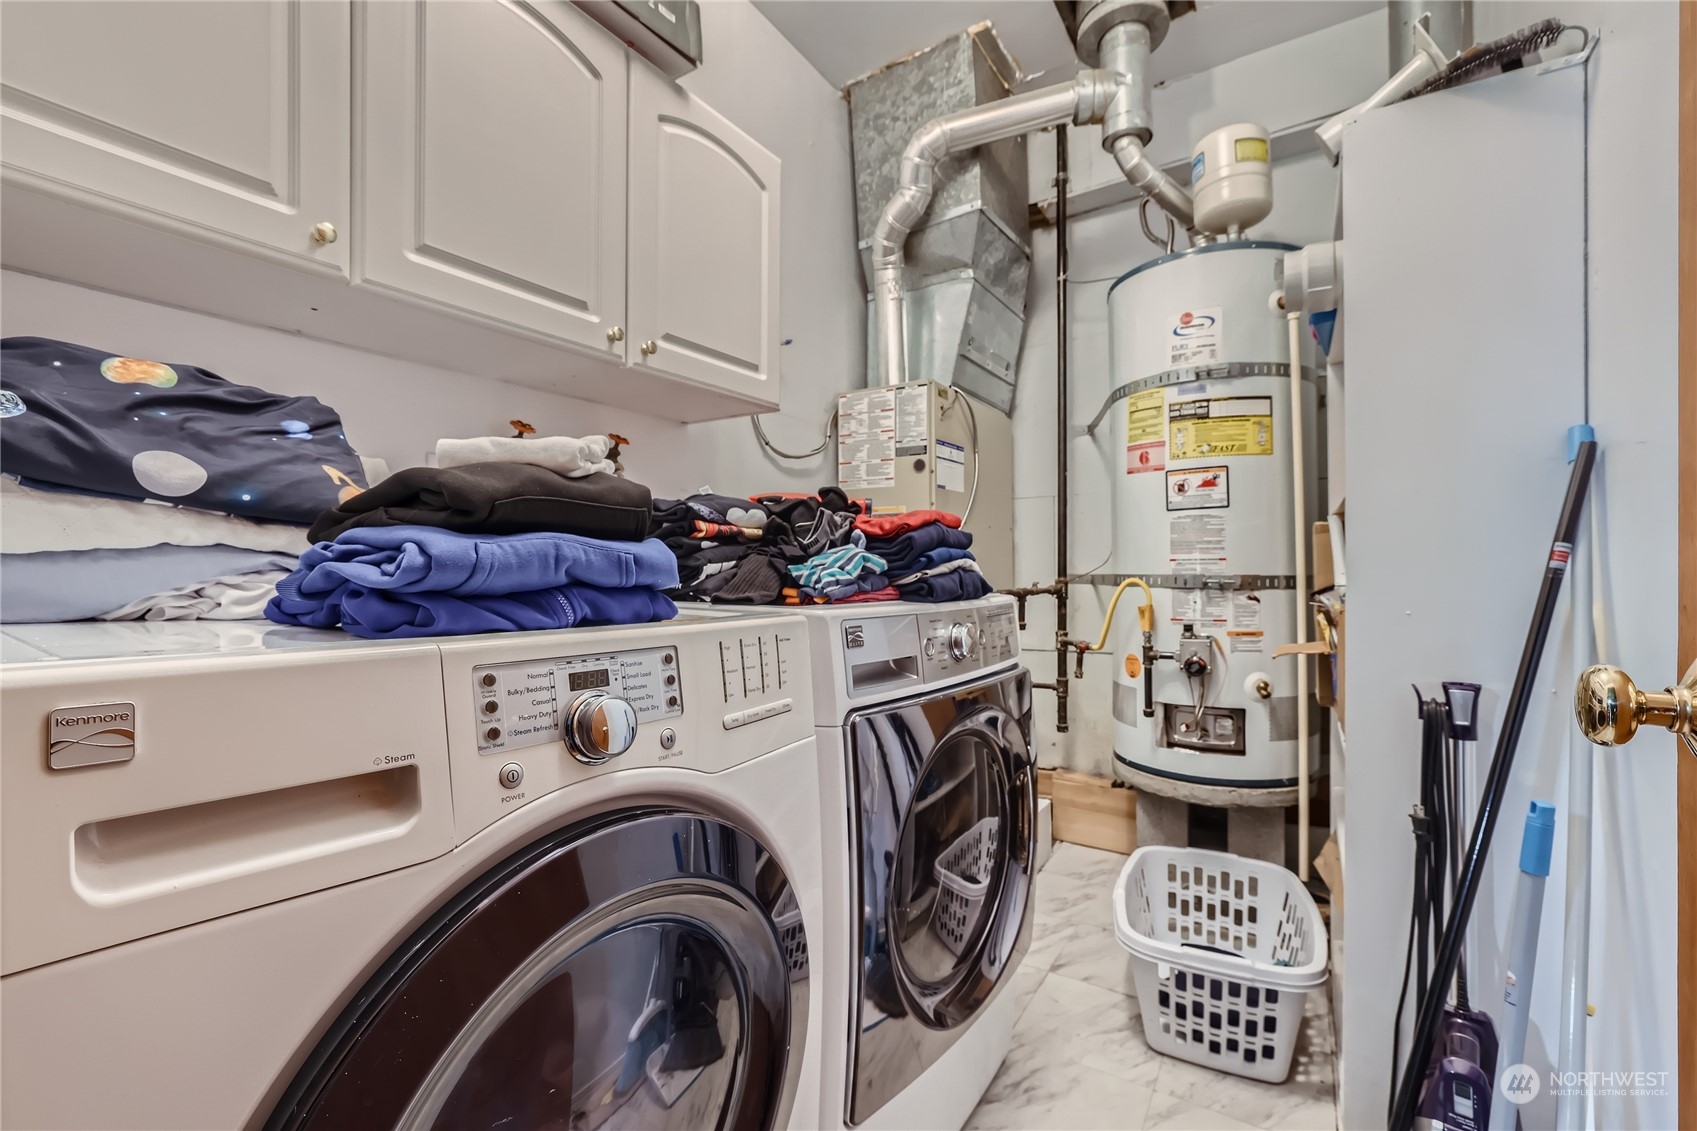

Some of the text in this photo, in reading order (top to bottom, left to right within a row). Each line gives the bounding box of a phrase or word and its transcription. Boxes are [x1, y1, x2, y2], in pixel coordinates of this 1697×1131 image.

[527, 672, 549, 680] Normal
[626, 672, 640, 680] Small
[640, 670, 652, 678] Load
[507, 685, 550, 697] Bulky/Bedding
[531, 698, 551, 706] Casual
[645, 693, 654, 701] Dry
[55, 712, 131, 728] Kenmore
[518, 711, 552, 722] Heavy Duty
[513, 724, 554, 737] Steam Refresh
[384, 753, 416, 765] Steam
[501, 792, 526, 804] POWER
